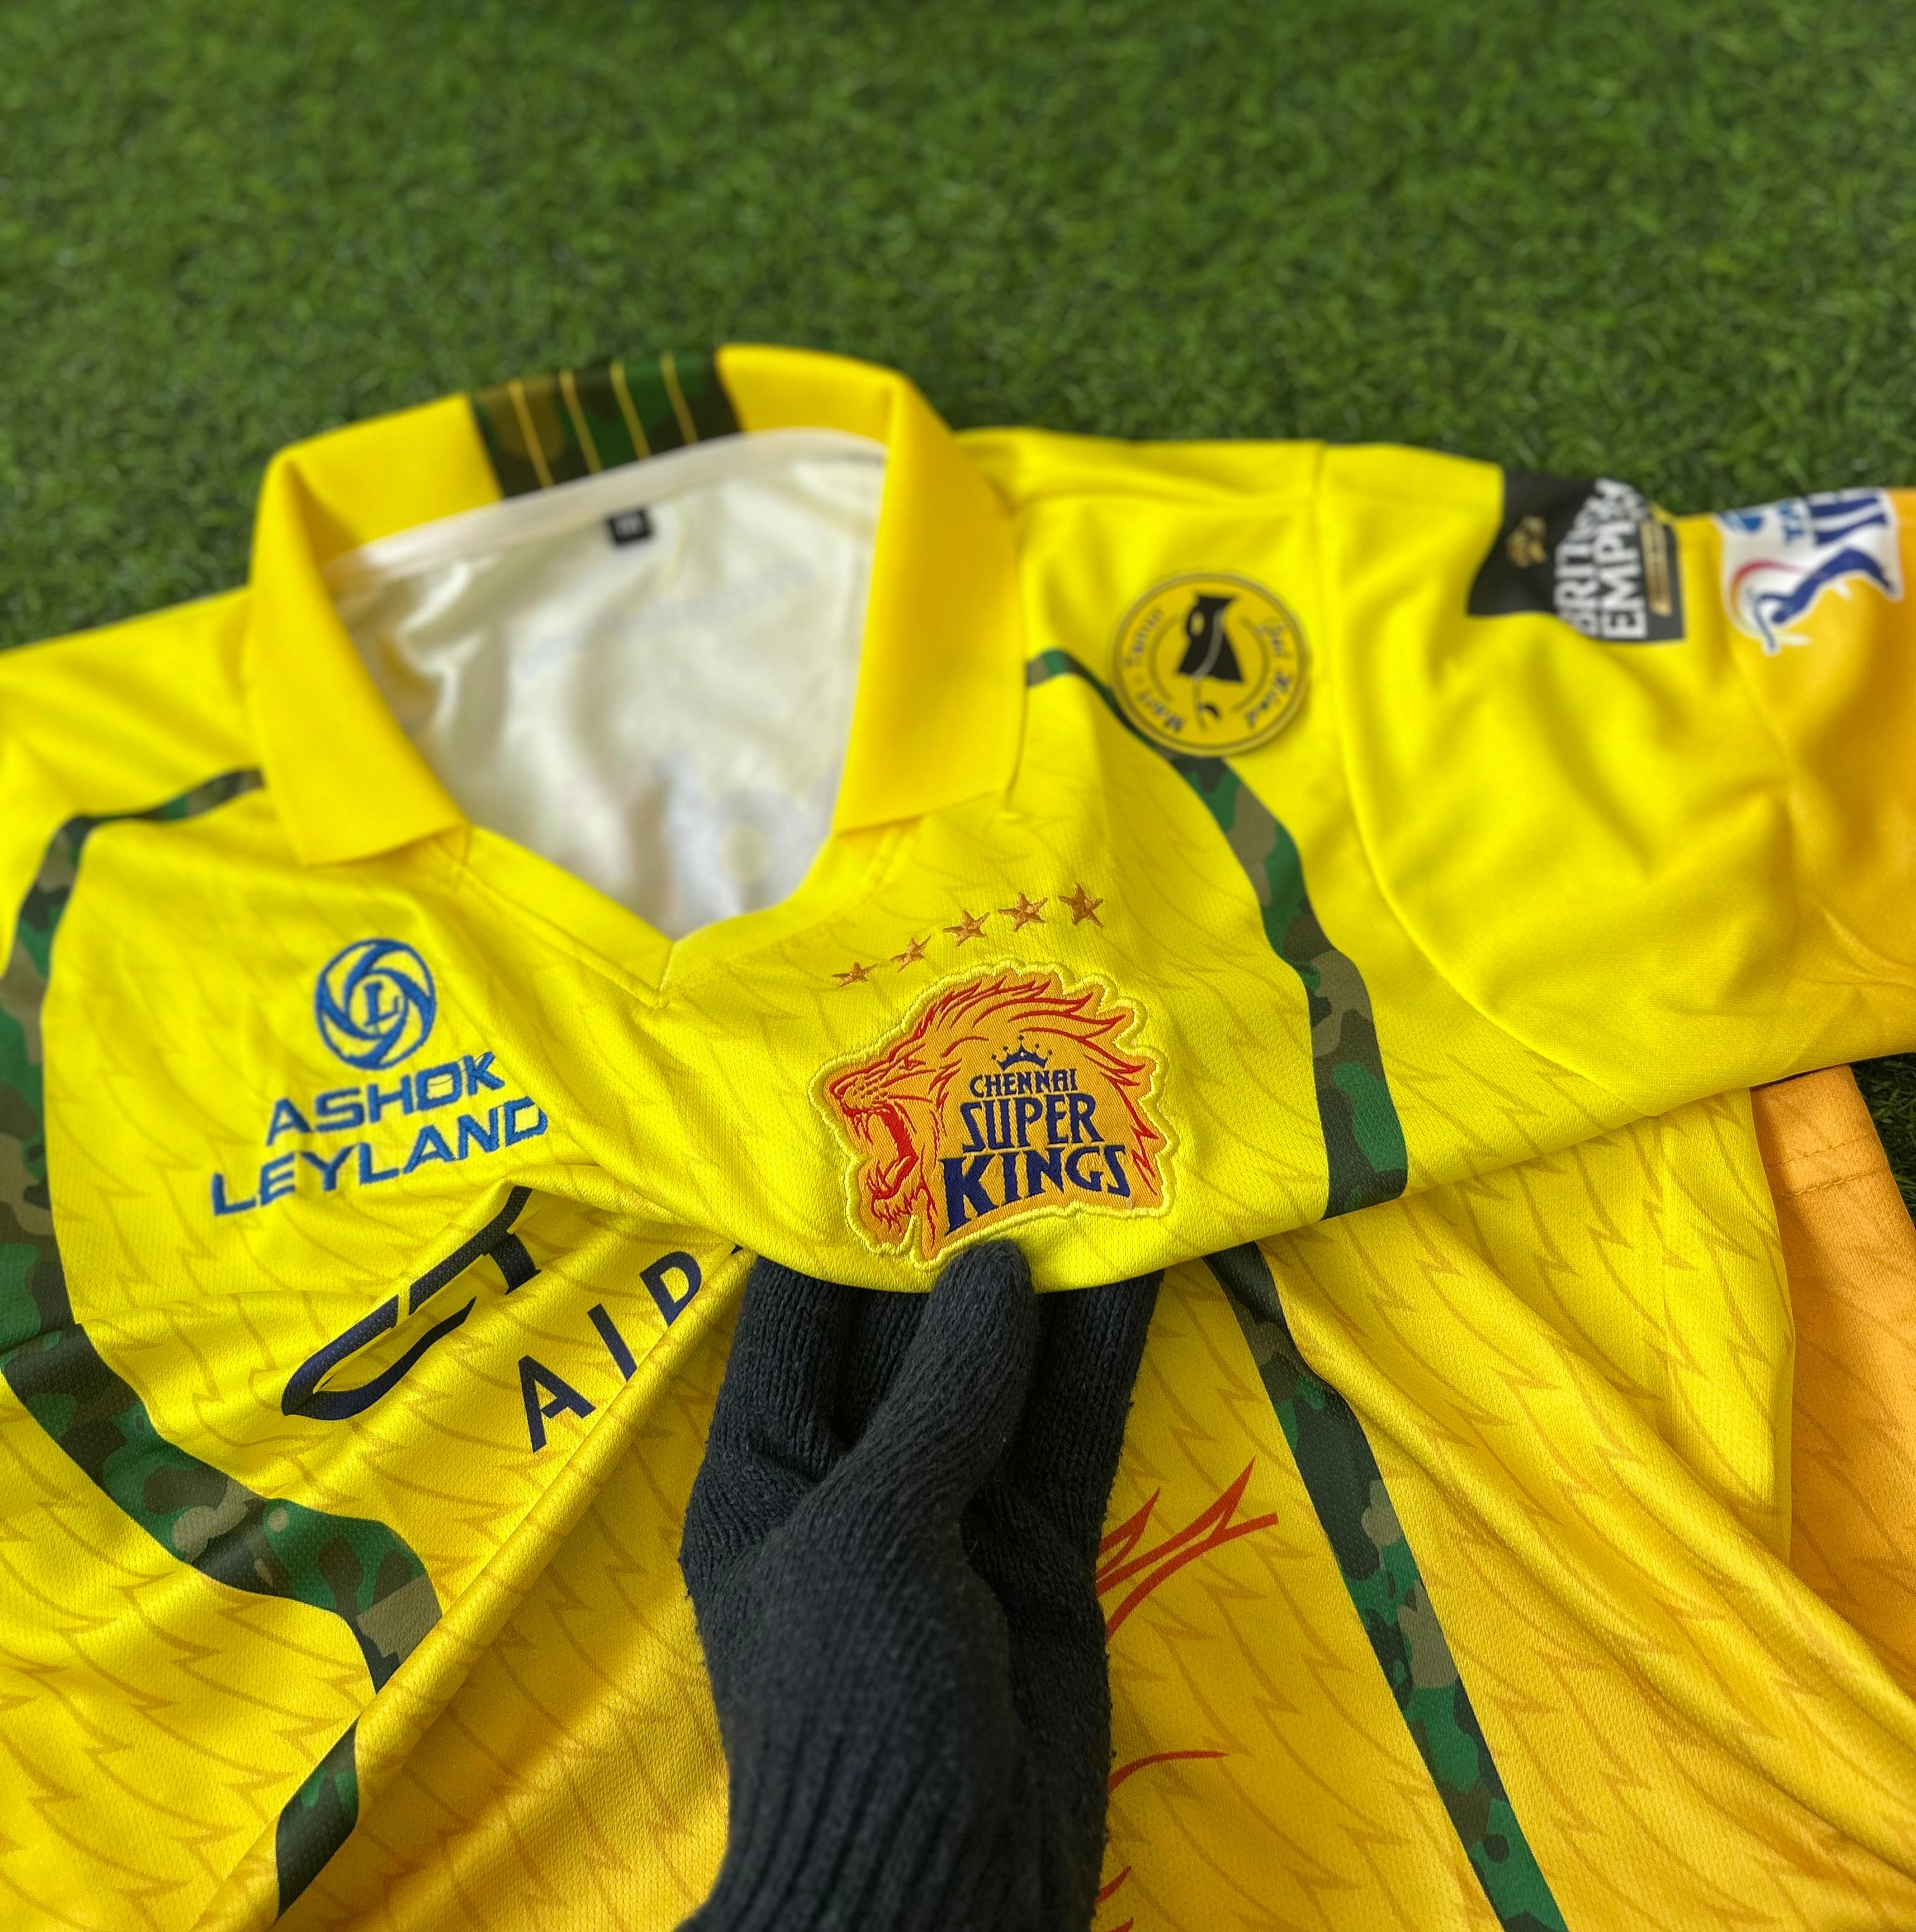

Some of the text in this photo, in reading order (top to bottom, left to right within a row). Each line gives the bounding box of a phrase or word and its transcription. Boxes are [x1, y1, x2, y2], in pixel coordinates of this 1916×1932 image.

[265, 1050, 506, 1148] ASHOK
[960, 1092, 1105, 1154] SUPER
[968, 1068, 1077, 1098] CHENNAI
[210, 1095, 549, 1217] LEYLAND
[939, 1144, 1131, 1237] KINGS
